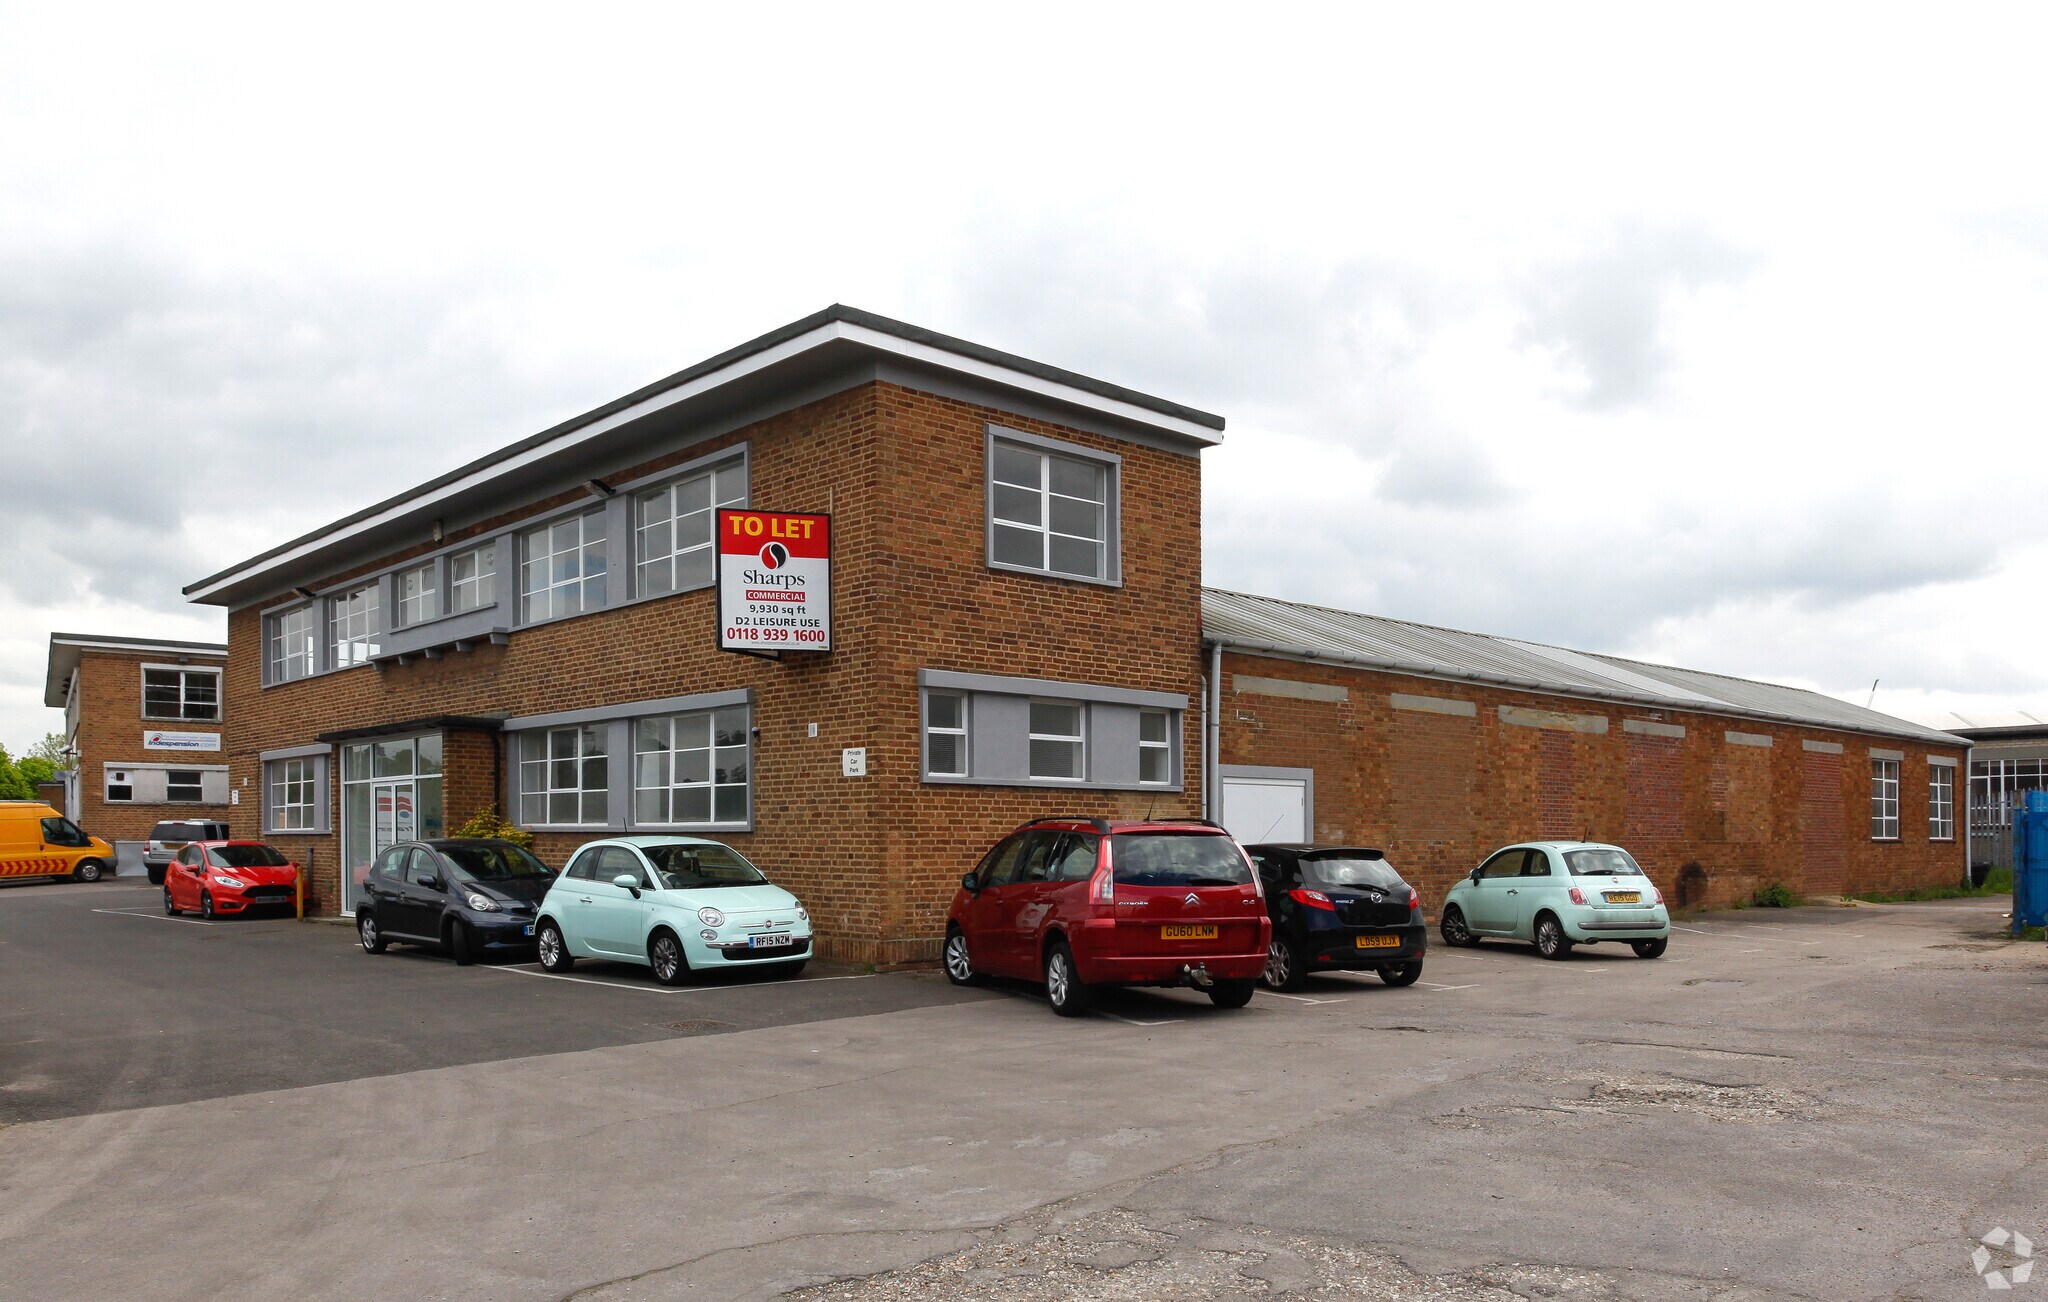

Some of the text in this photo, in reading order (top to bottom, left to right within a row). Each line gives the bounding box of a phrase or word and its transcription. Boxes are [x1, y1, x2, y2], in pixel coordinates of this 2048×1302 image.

[729, 516, 815, 539] TO LET
[743, 569, 806, 590] Sharps
[747, 591, 805, 601] COMMERCIAL
[750, 604, 807, 616] 9,930 sq ft
[735, 617, 820, 628] D2 LEISURE USE
[727, 627, 826, 643] 0118 939 1600
[1165, 926, 1193, 937] GU60
[756, 935, 790, 946] RF15 NZM
[1359, 936, 1397, 947] LD59 UJX
